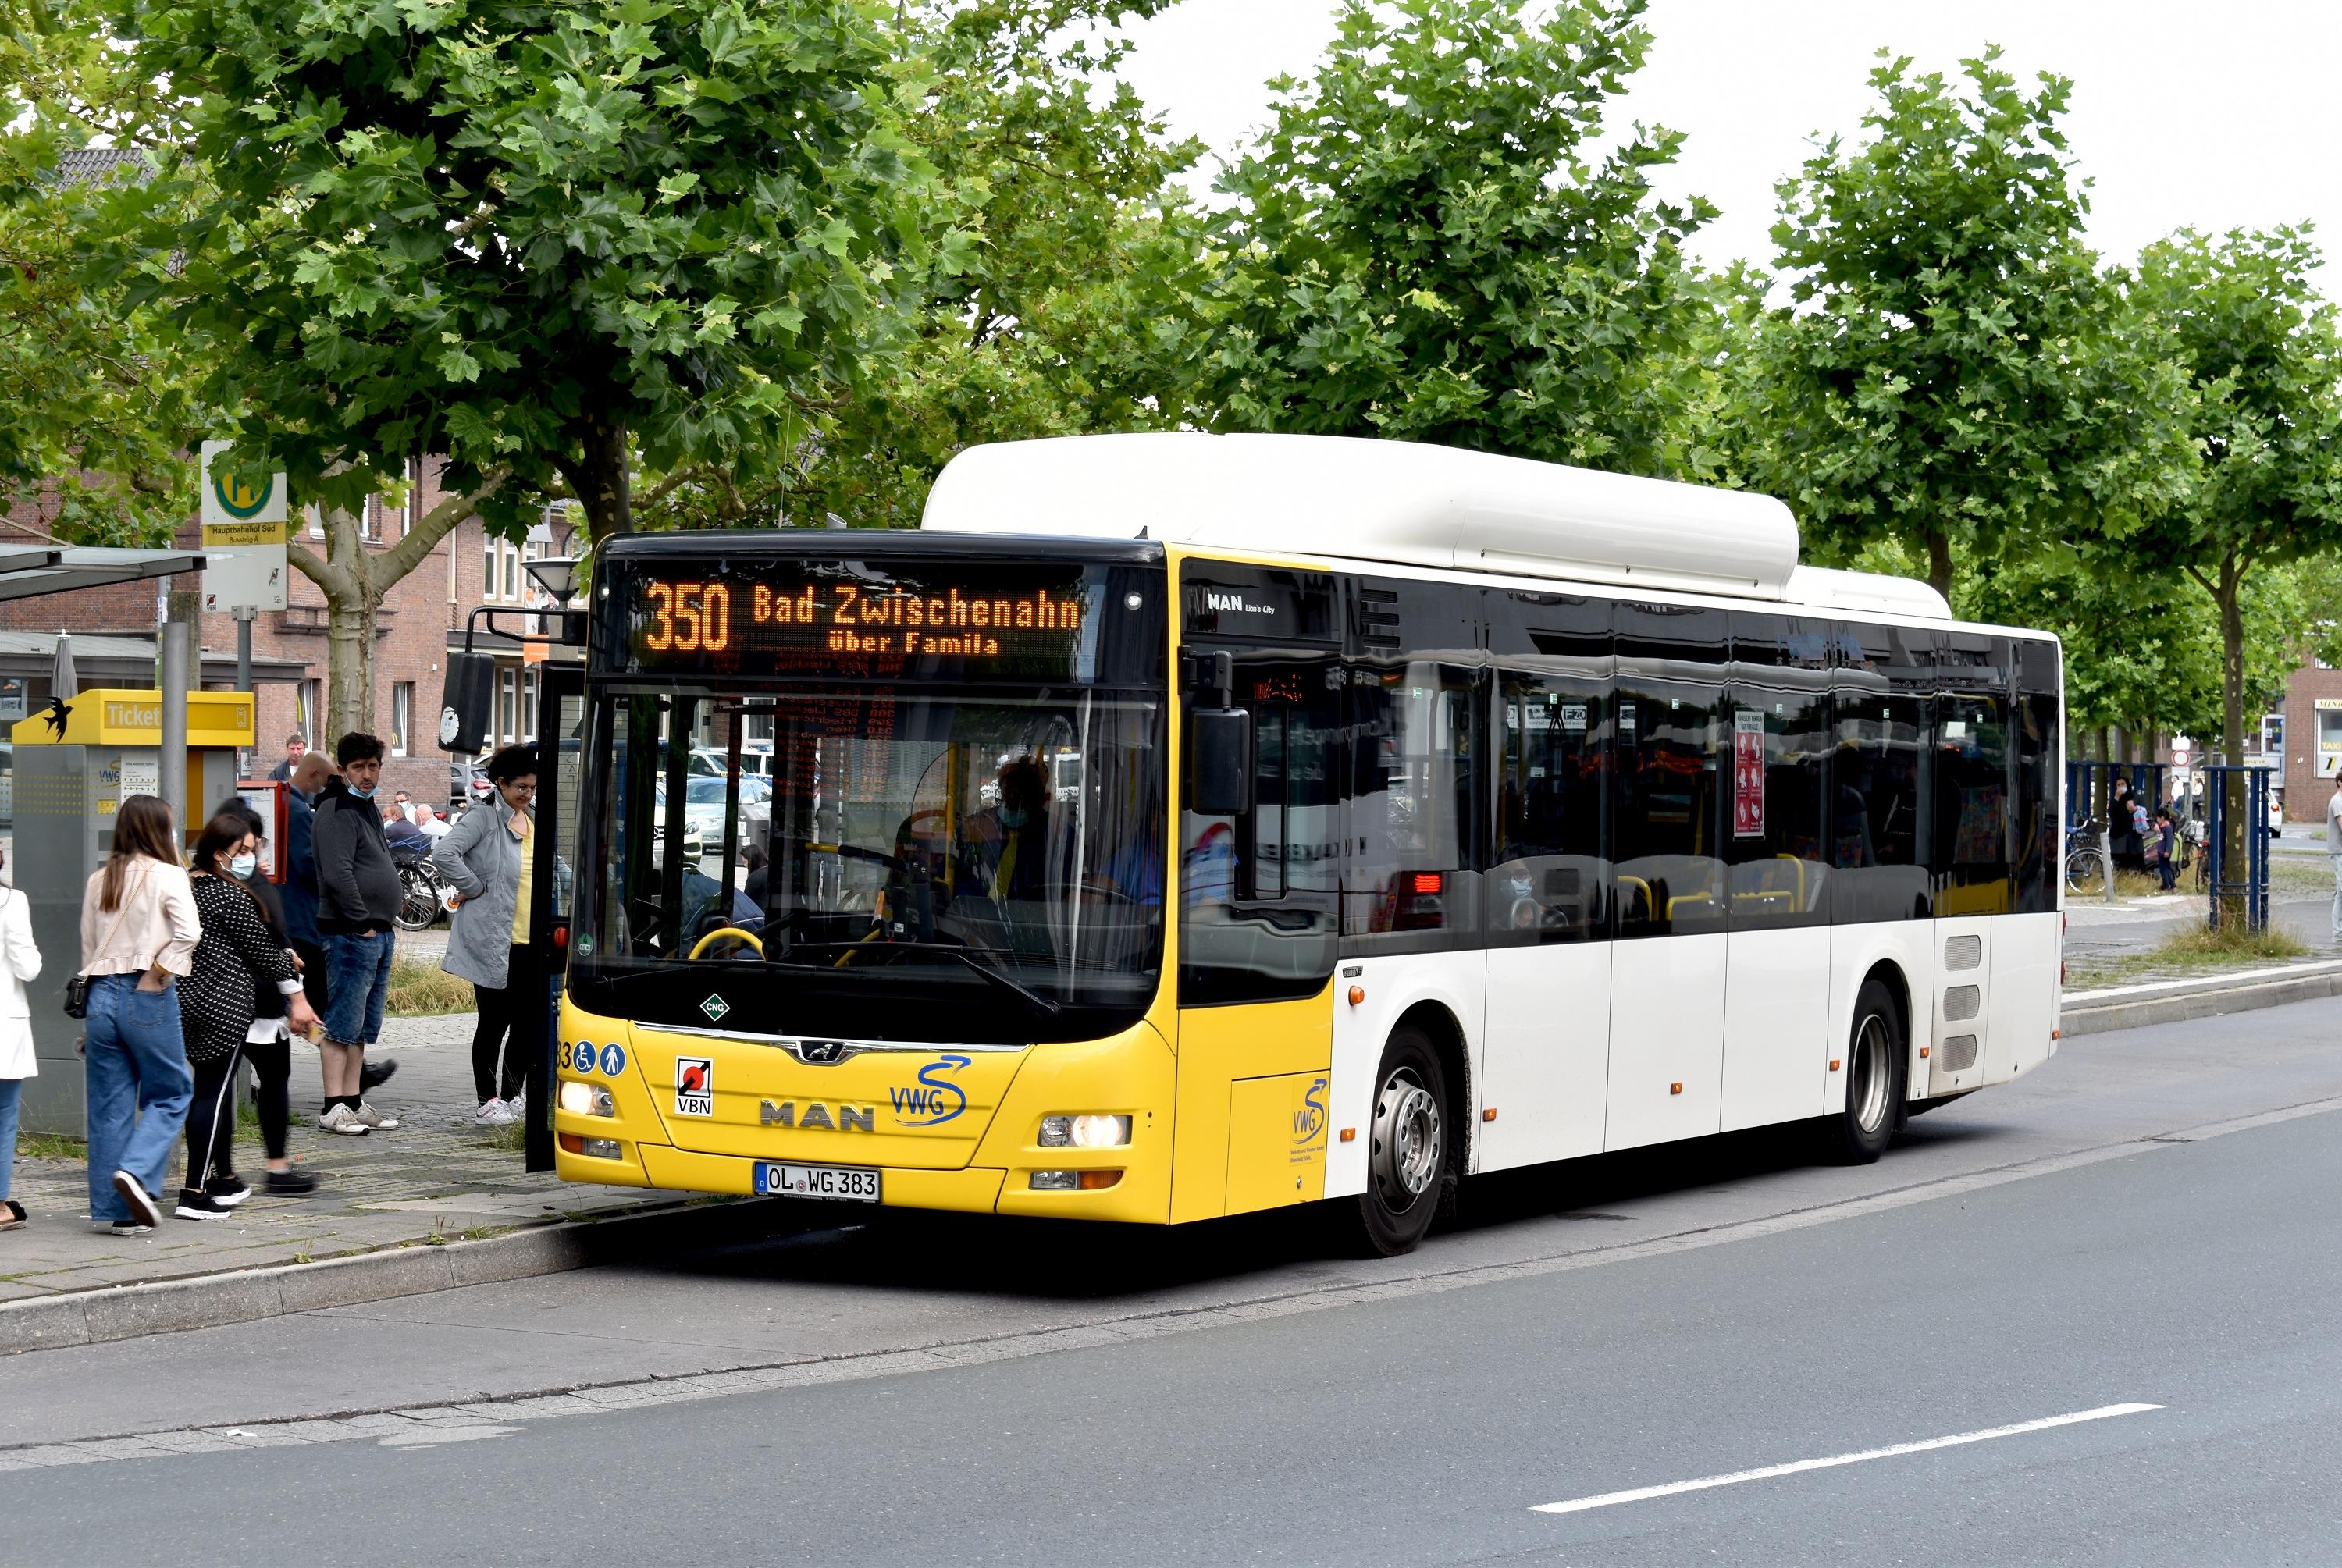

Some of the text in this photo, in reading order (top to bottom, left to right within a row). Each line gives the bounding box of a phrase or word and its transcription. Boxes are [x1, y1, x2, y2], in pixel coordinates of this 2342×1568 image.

[212, 526, 260, 535] Hauptbahnhof
[753, 585, 1079, 629] Bad Zwischenahn
[1208, 593, 1275, 615] MAN Lion's City
[646, 584, 729, 651] 350
[829, 630, 999, 655] über Famila
[106, 704, 160, 727] Ticket
[99, 770, 120, 782] VWG
[706, 1003, 724, 1012] CNG
[678, 1098, 710, 1115] VBN
[890, 1086, 945, 1115] VWG
[760, 1099, 875, 1132] MAN
[1294, 1108, 1315, 1134] VWG
[769, 1168, 875, 1195] OL WG 383
